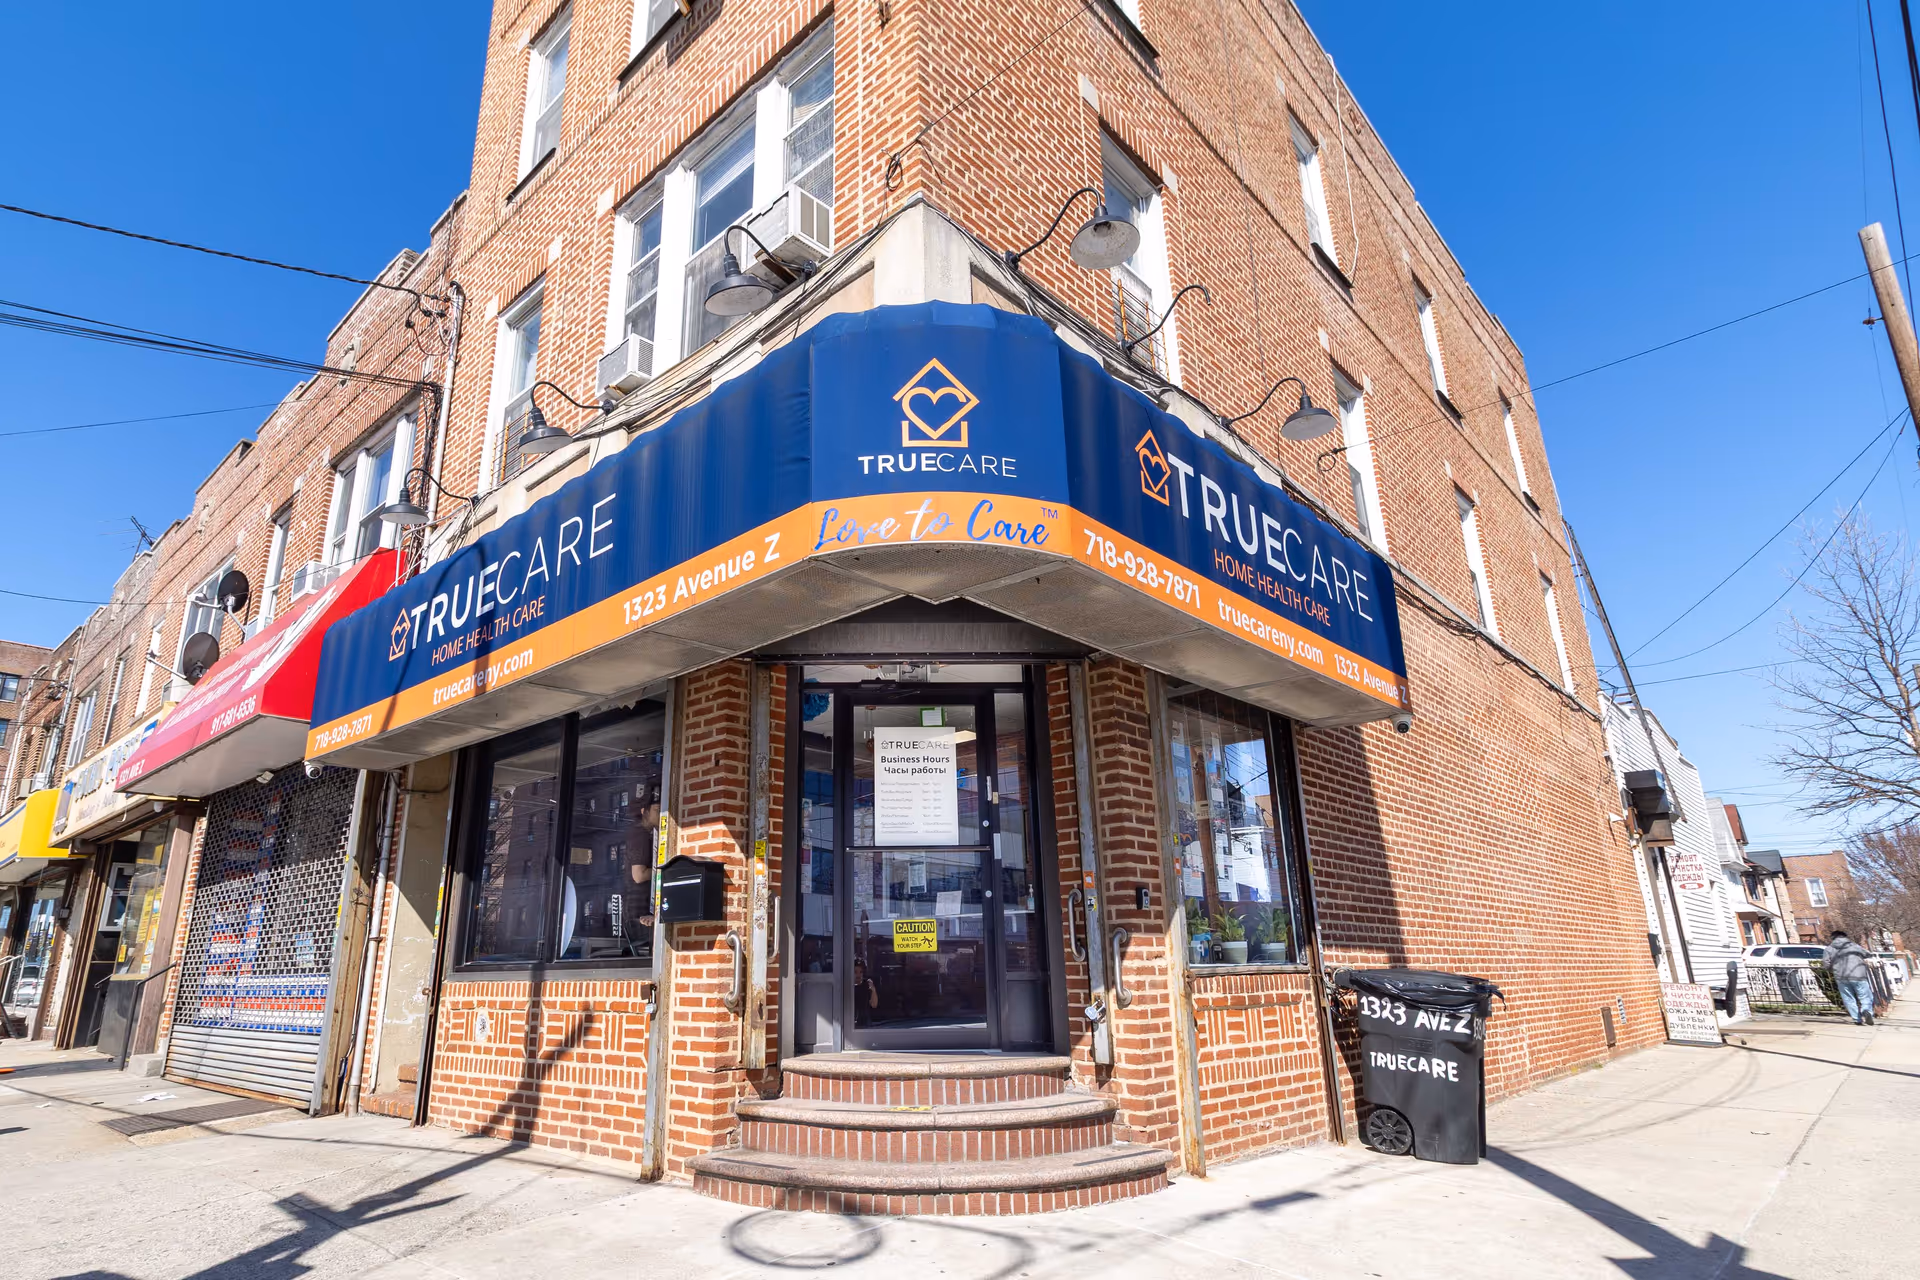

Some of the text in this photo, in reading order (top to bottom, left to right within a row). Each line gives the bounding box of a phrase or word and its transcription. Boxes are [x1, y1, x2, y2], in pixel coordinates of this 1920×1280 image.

[858, 452, 1017, 478] TRUECARE
[814, 508, 901, 551] Love
[904, 498, 954, 542] to
[967, 499, 1050, 545] Care
[1167, 453, 1373, 622] TRUECARE
[410, 492, 617, 649] TRUECARE
[624, 532, 781, 625] 1323 Avenue Z
[1214, 549, 1331, 627] HOME HEALTH CARE
[432, 595, 545, 666] HOME HEALTH CARE
[1084, 528, 1408, 703] 718-928-7871 truecareny.com 1323 Avenue Z
[433, 647, 533, 705] truecareny.com
[314, 713, 372, 751] 718-928-7871
[889, 741, 950, 749] TRUECARE
[911, 766, 946, 776] работы
[896, 922, 934, 932] CAUTION
[1664, 984, 1703, 992] РЕМОНТ
[1666, 1000, 1709, 1009] ОДЕЖДЫ
[1671, 992, 1709, 1000] ЧИСТКА
[1360, 996, 1407, 1026] 1323
[1414, 1009, 1451, 1031] AVE
[1454, 1012, 1472, 1034] Z
[1370, 1052, 1459, 1082] TRUECARE
